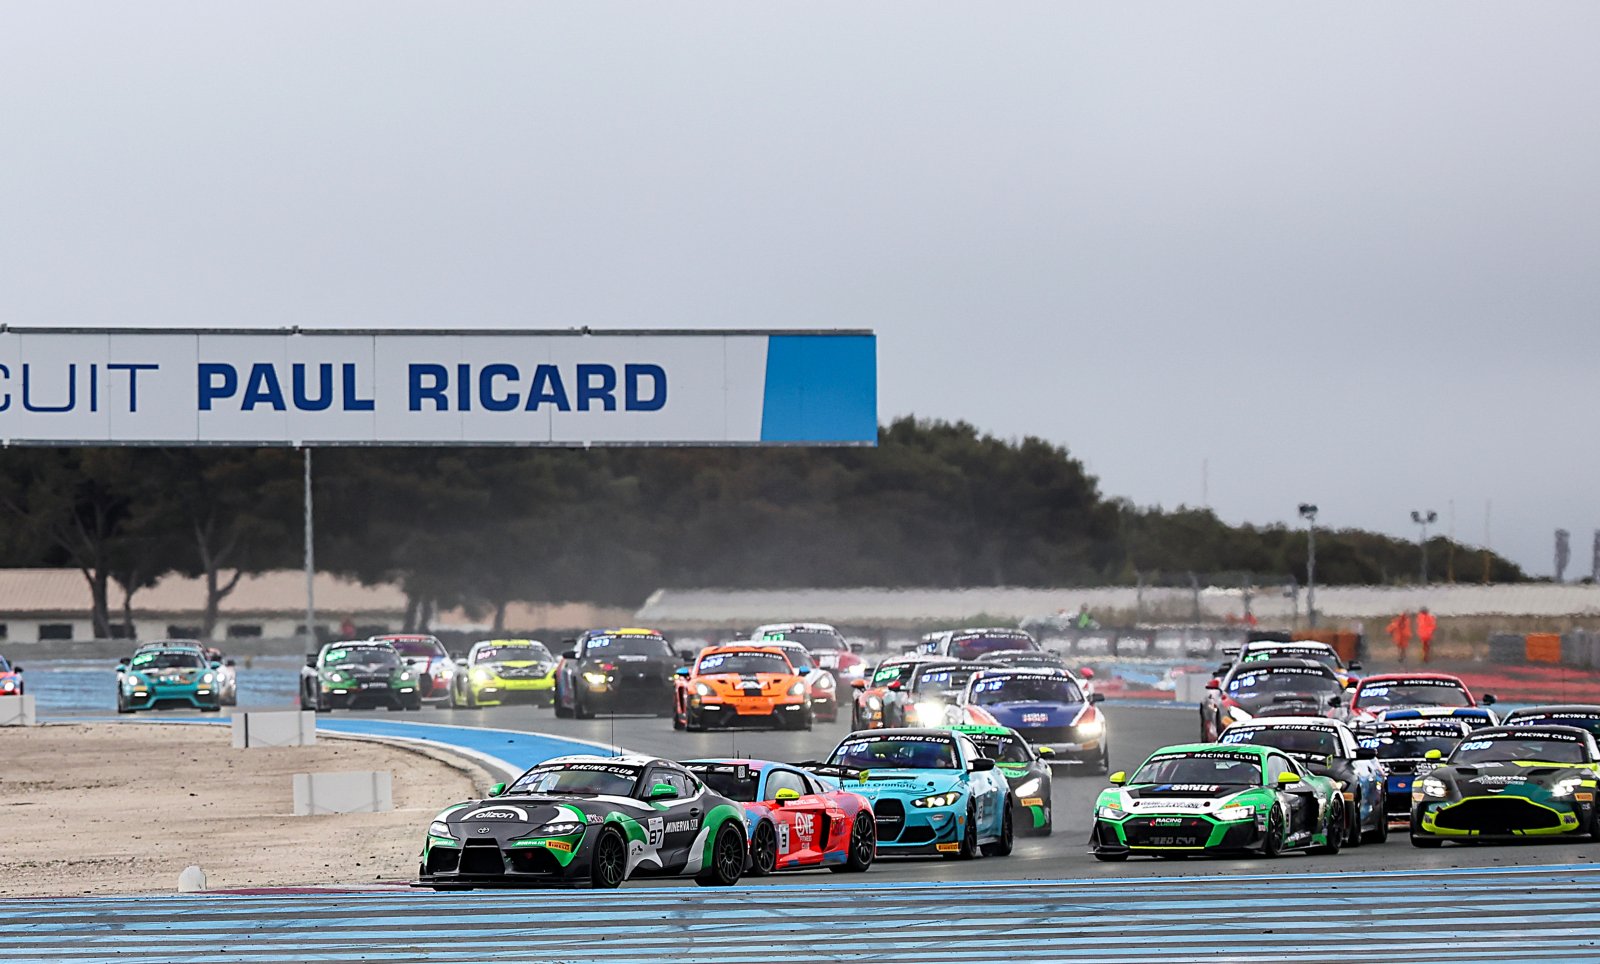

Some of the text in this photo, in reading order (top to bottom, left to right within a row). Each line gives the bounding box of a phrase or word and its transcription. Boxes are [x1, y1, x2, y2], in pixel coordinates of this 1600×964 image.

[0, 363, 667, 412] UIT PAUL RICARD
[1309, 725, 1335, 733] CLUB
[1399, 730, 1433, 738] RACING
[1434, 730, 1458, 738] CLUB
[925, 736, 950, 744] CLUB
[1551, 733, 1577, 741] CLUB
[570, 764, 604, 772] RACING
[607, 766, 635, 776] CLUB
[664, 820, 690, 834] MINERVA
[649, 829, 663, 846] 87
[781, 834, 787, 848] 3
